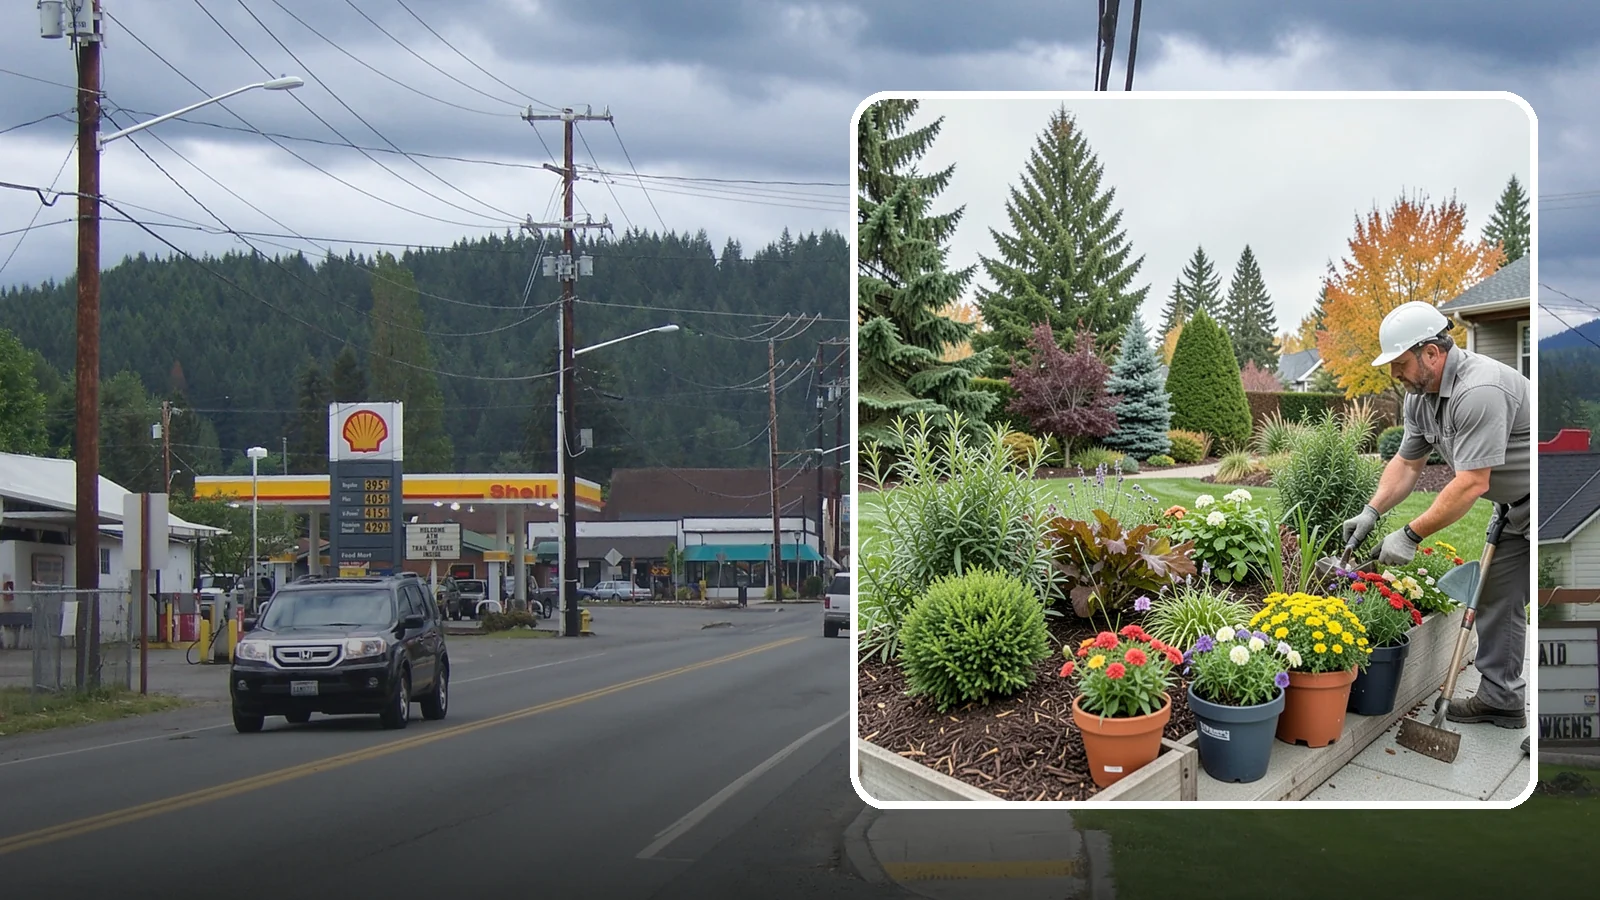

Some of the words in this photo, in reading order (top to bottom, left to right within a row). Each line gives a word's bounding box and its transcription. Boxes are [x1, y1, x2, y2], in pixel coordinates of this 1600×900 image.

[366, 480, 383, 490] 395
[490, 484, 547, 499] Shell
[365, 494, 383, 504] 405
[365, 508, 383, 518] 415
[365, 522, 383, 533] 429
